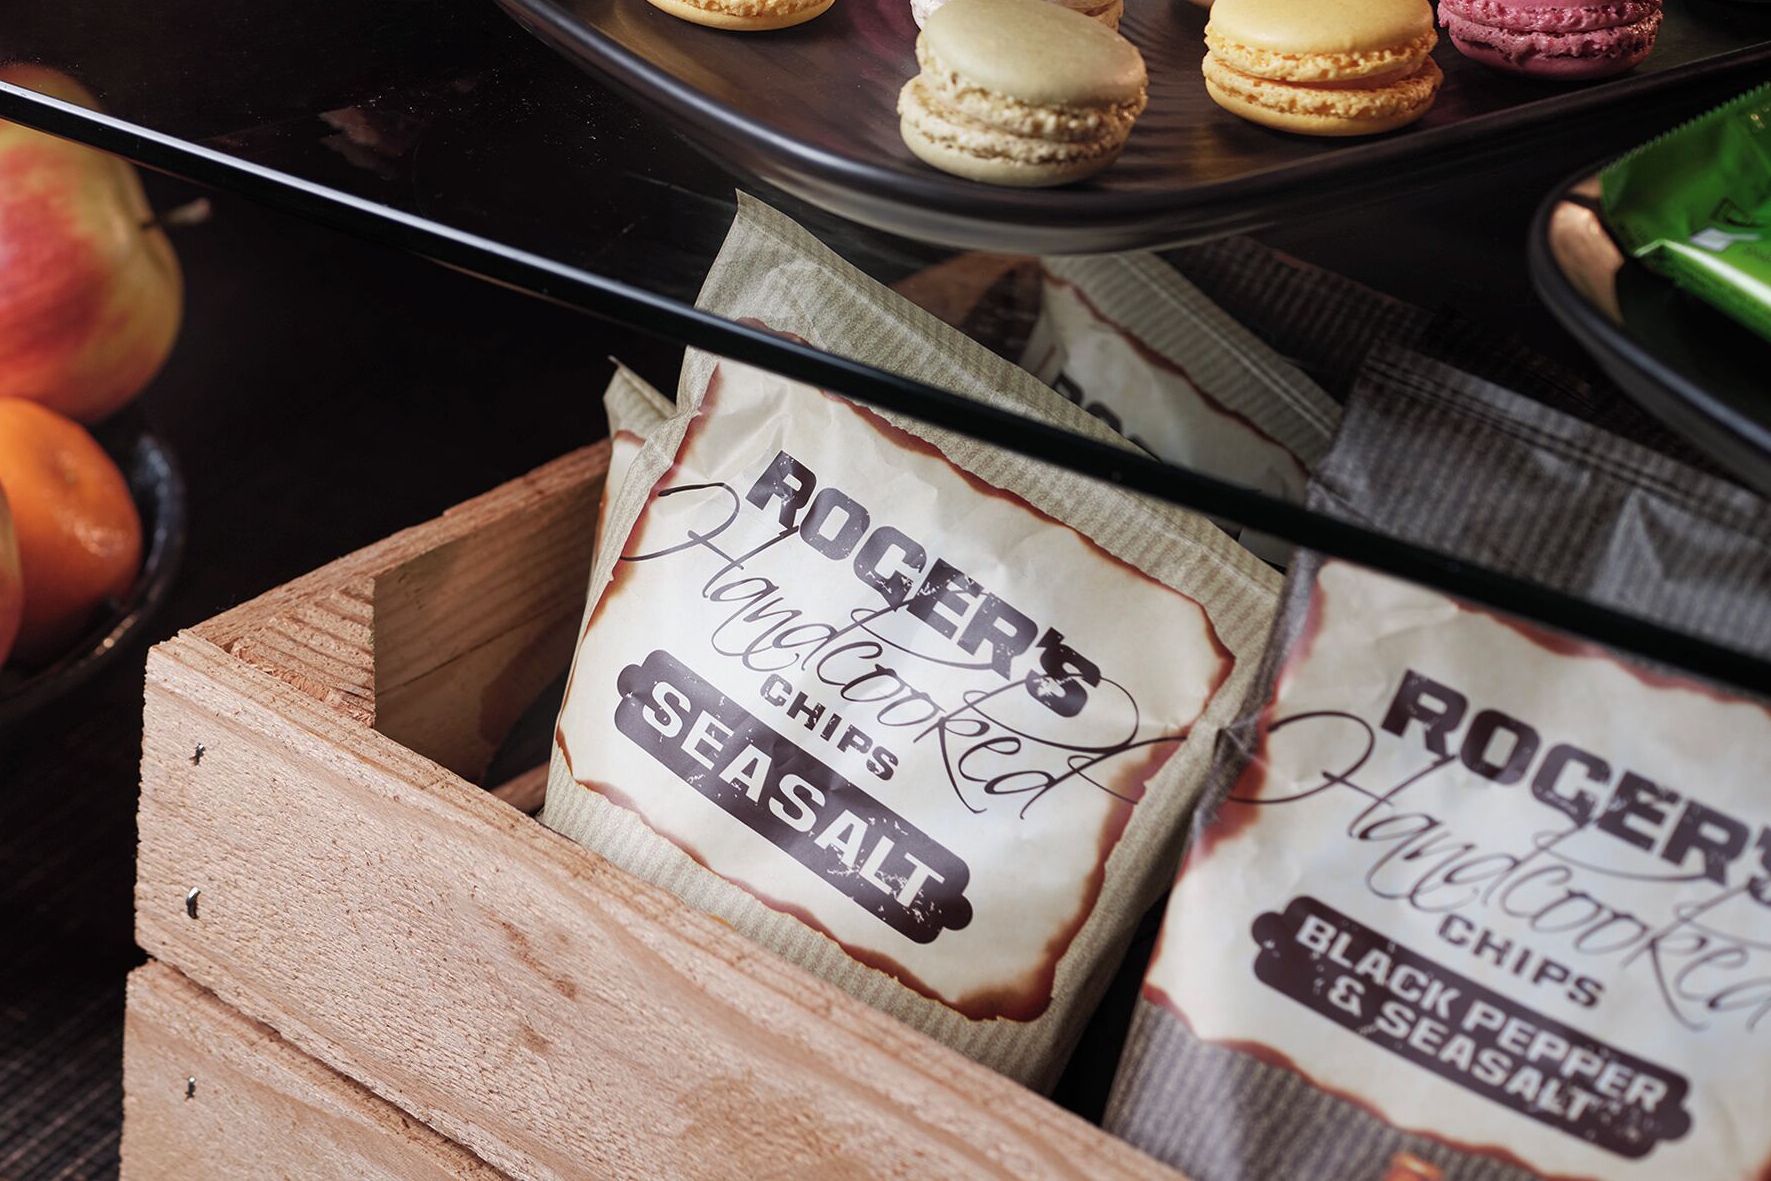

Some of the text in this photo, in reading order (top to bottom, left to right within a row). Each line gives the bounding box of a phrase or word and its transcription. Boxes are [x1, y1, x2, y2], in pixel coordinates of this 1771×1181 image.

[619, 481, 1188, 820] Handcooked
[744, 450, 1102, 718] ROGER'S
[641, 680, 946, 908] SEASALT
[759, 673, 900, 782] CHIPS
[1294, 914, 1669, 1113] BLACK PEPPER
[1326, 974, 1600, 1122] & SEASALT
[1437, 913, 1607, 1010] CHIPS
